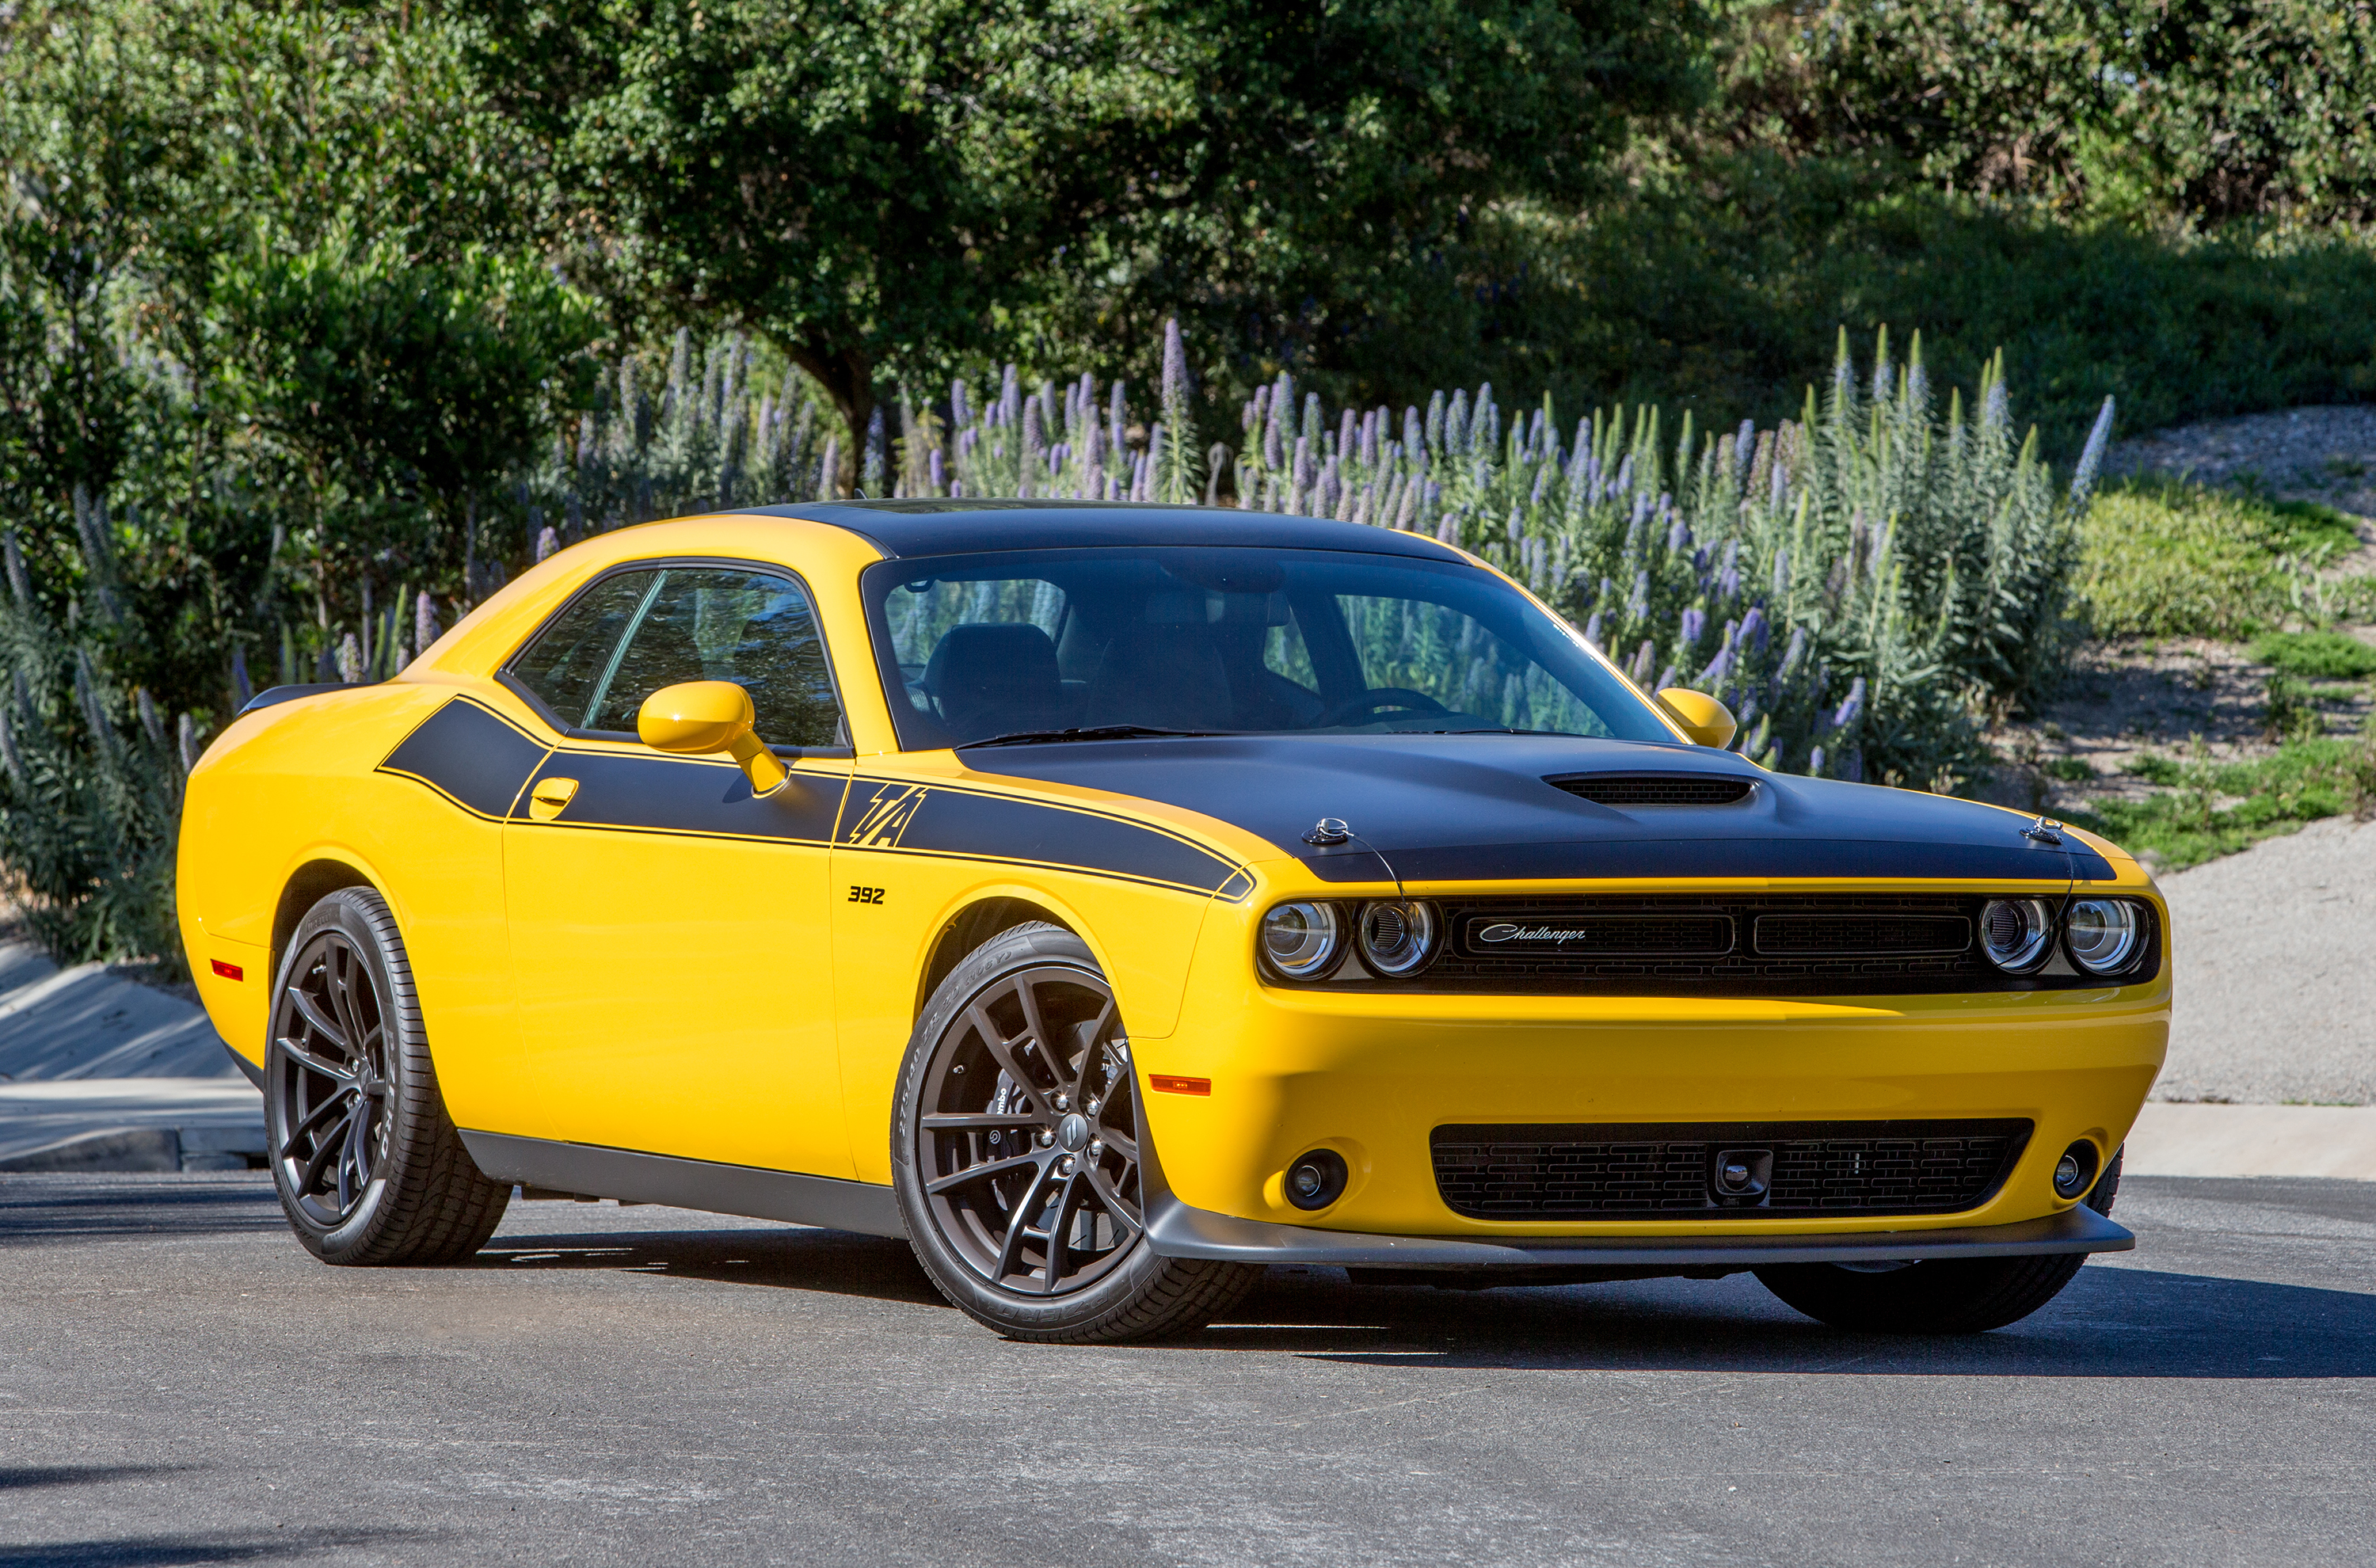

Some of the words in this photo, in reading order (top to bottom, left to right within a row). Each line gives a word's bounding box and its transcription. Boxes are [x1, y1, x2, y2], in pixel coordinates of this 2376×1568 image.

[847, 885, 885, 905] 392
[1479, 923, 1586, 945] Challenger
[899, 1048, 921, 1137] 275/40
[921, 1012, 940, 1047] ZR
[942, 984, 961, 1013] 20
